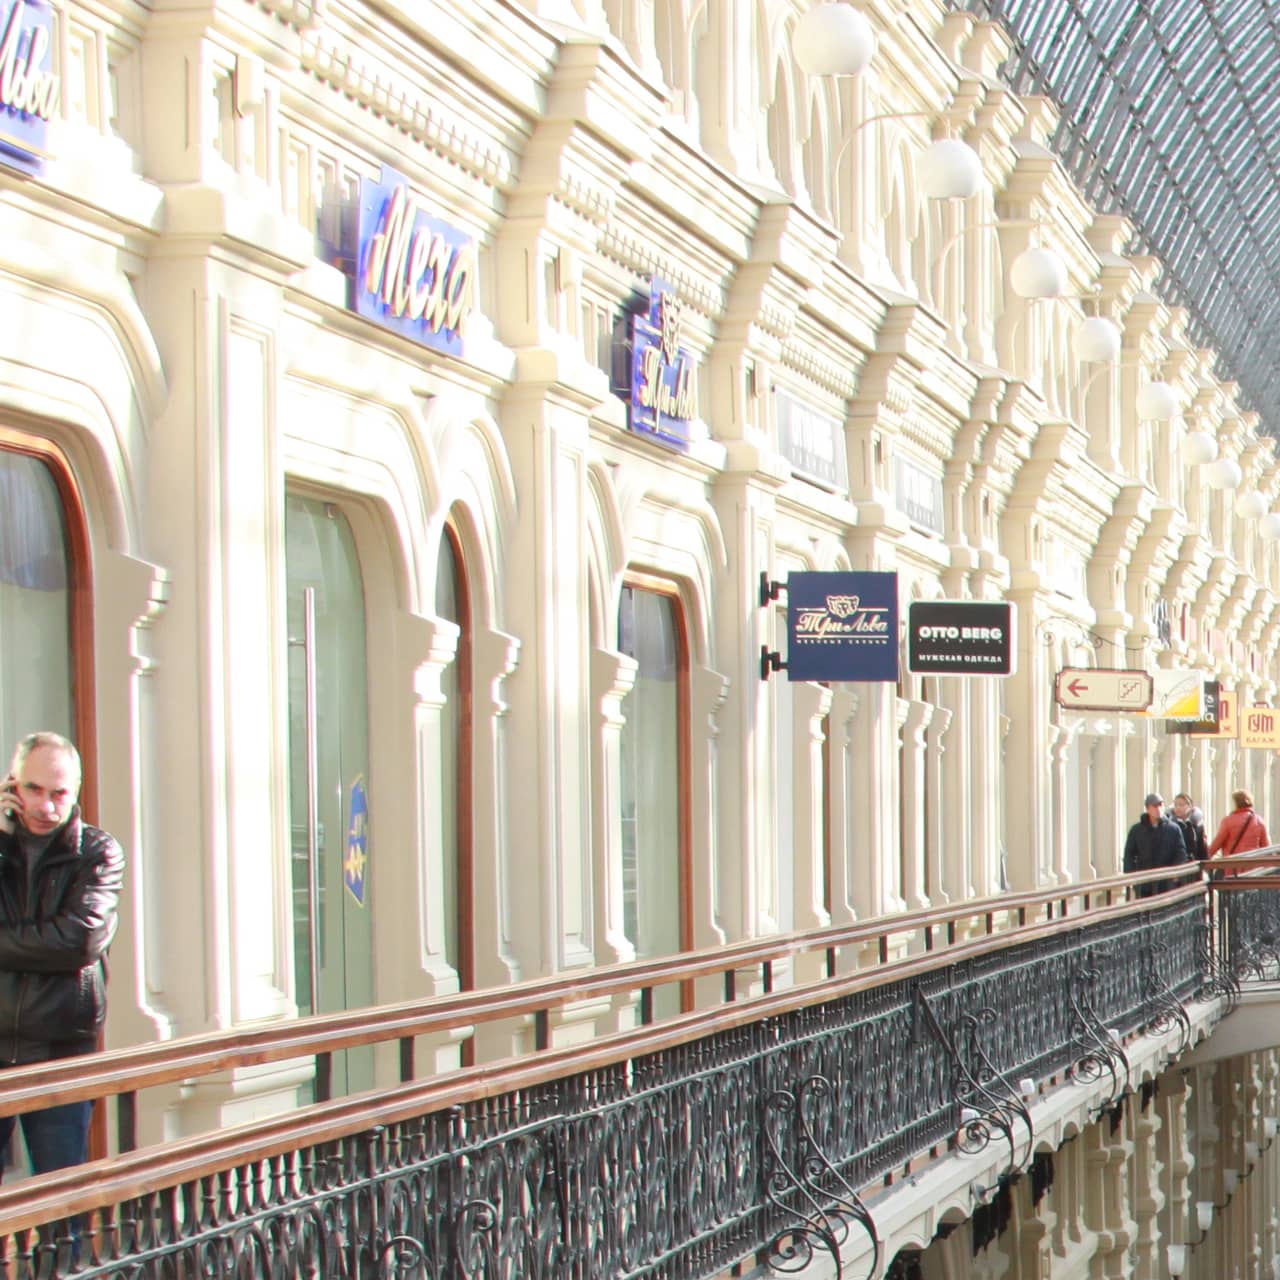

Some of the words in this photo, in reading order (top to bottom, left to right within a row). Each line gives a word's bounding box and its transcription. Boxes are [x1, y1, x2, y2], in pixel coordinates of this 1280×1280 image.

[366, 183, 476, 337] Меха
[795, 612, 843, 638] Три
[843, 612, 889, 632] Льва
[918, 626, 959, 639] OTTO
[962, 626, 1003, 640] BERG
[964, 655, 1003, 663] ОДЕЖДА
[1248, 714, 1274, 733] ГУМ
